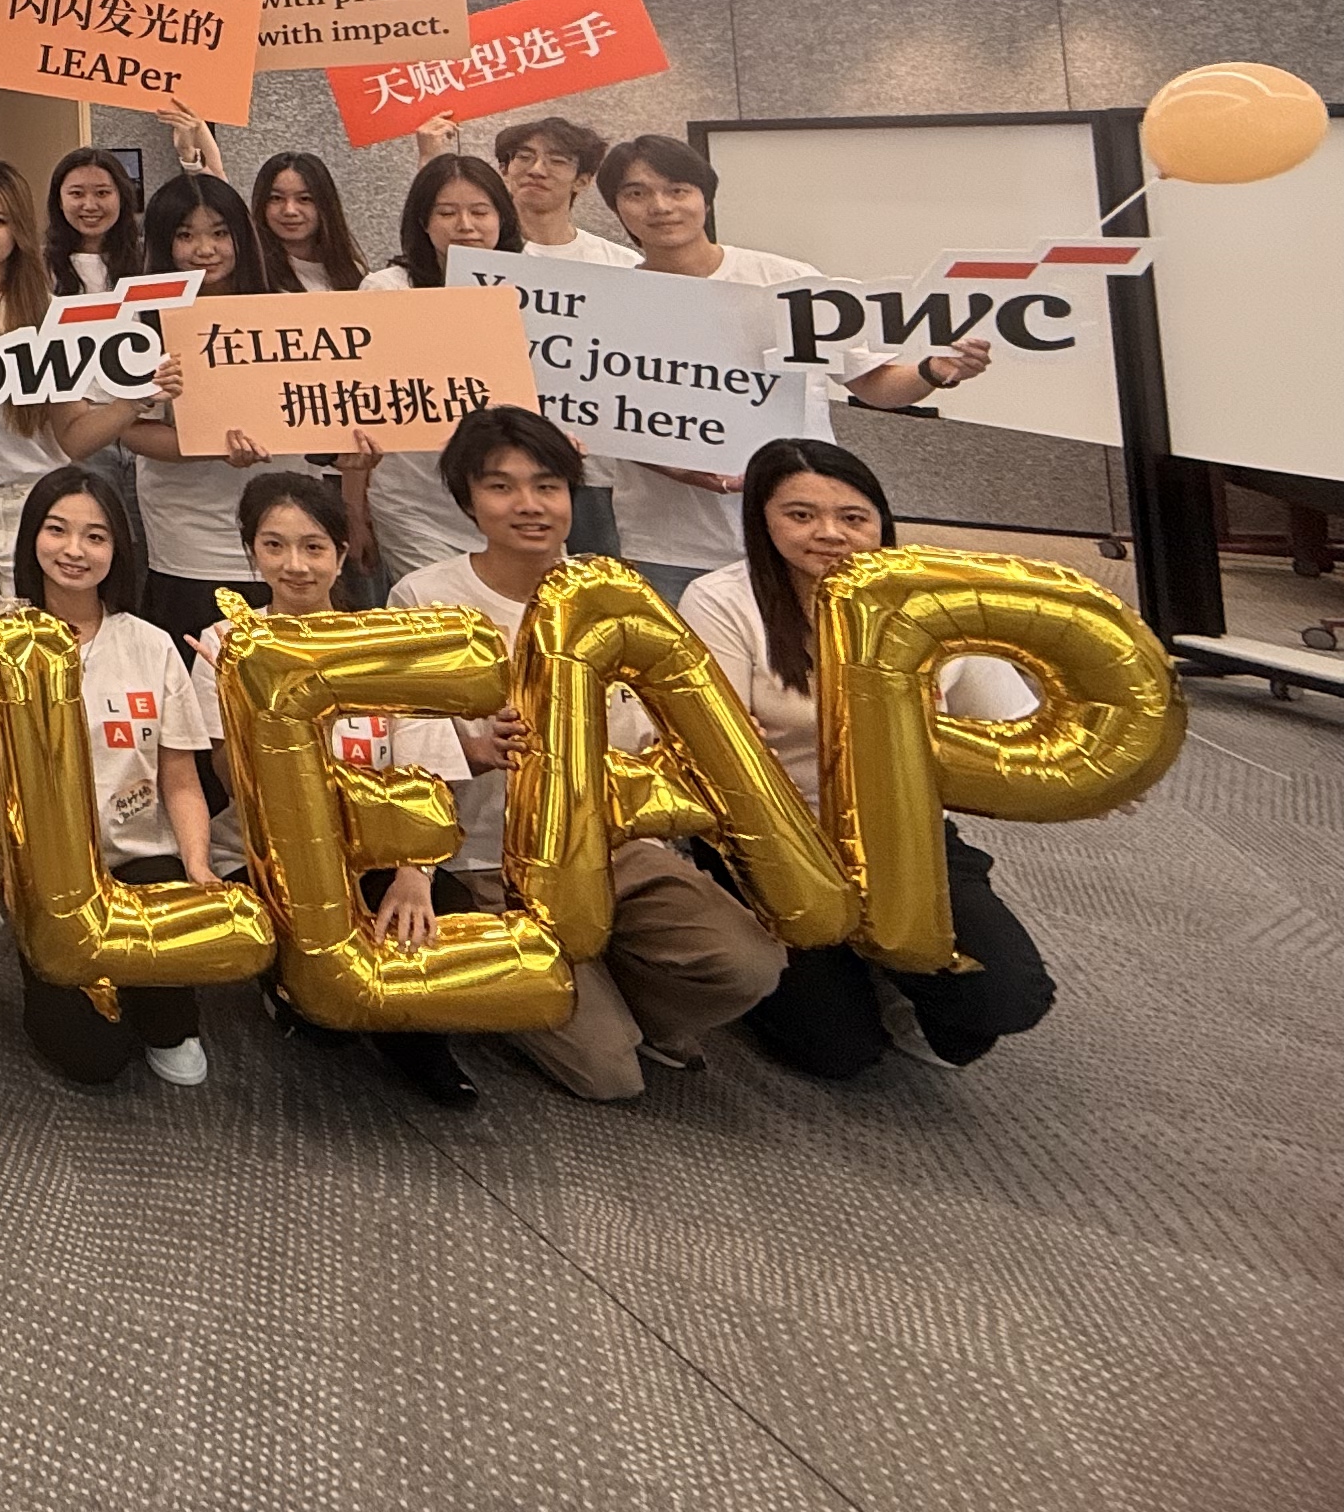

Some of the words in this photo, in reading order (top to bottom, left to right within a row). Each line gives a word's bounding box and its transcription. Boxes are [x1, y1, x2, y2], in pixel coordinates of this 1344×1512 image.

[258, 24, 324, 47] with
[331, 15, 450, 48] impact.
[38, 44, 182, 95] LEAPer
[362, 10, 618, 116] 天赋型选手
[197, 324, 373, 370] 在LEAP
[775, 286, 1077, 365] pwc
[580, 338, 782, 407] journey
[280, 378, 491, 429] 拥抱挑战
[614, 394, 727, 446] here
